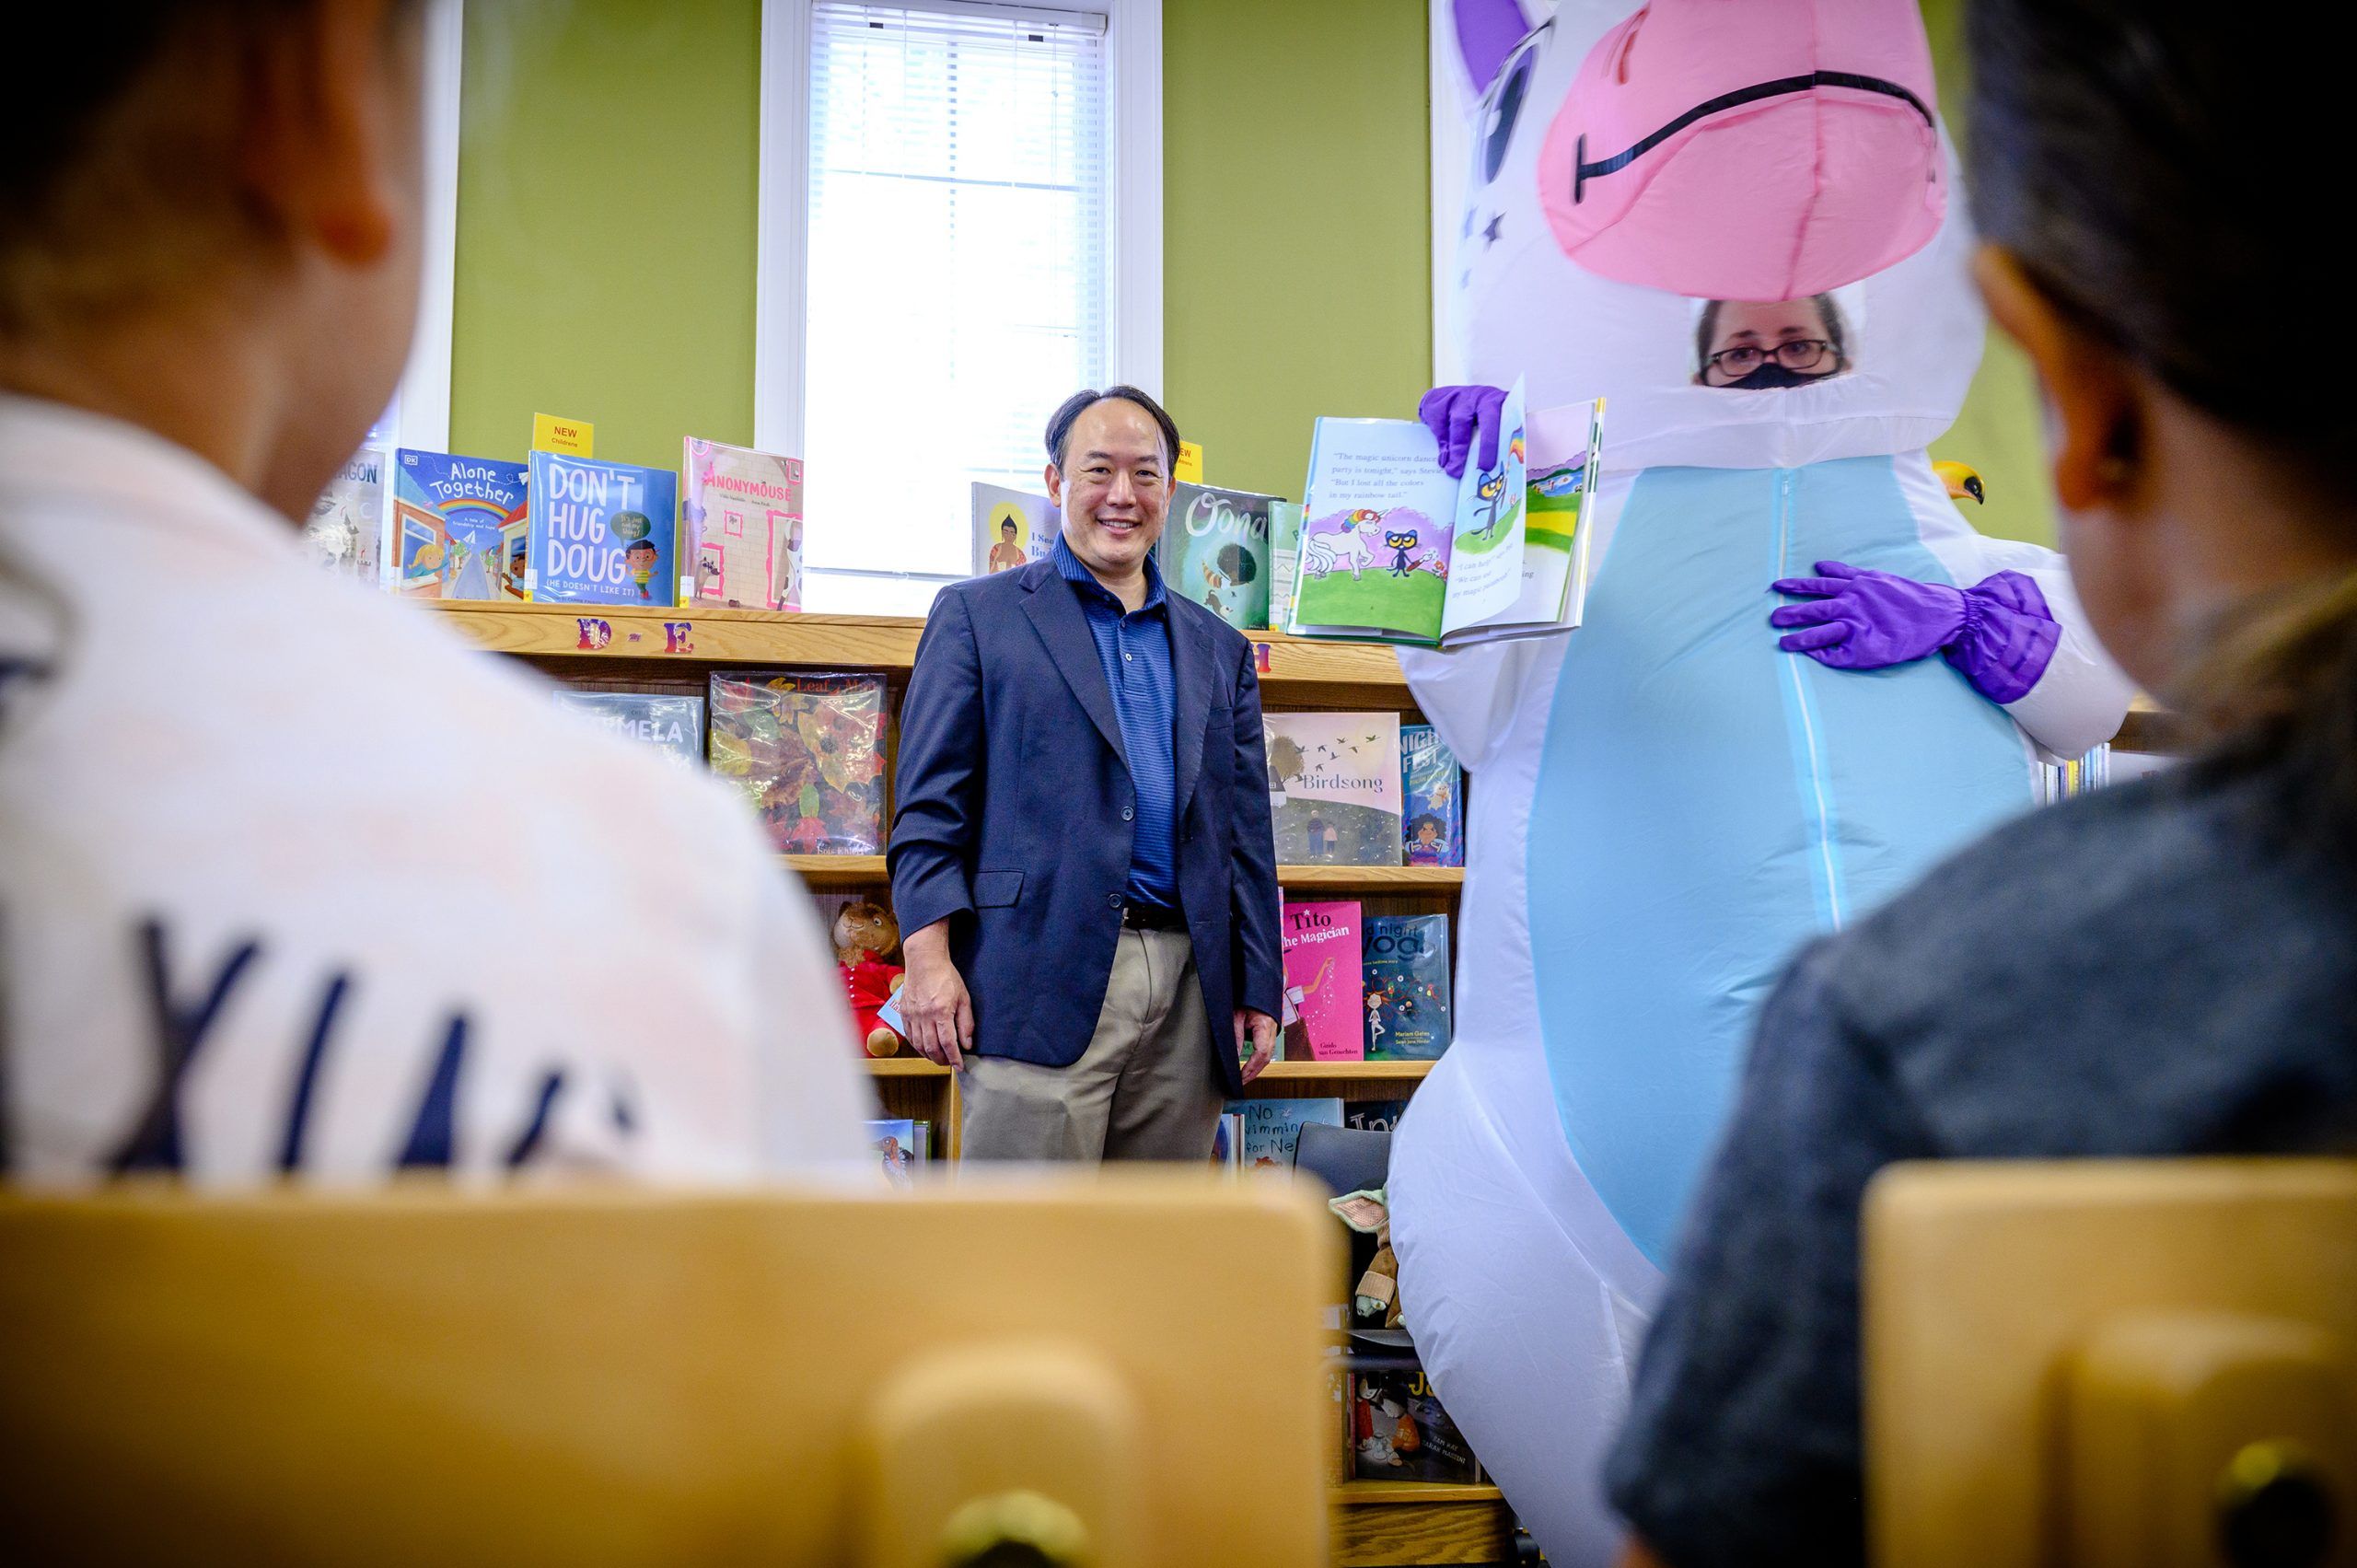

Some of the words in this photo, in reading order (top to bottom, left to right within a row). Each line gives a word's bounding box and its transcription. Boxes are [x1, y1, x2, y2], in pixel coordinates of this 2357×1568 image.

[552, 437, 578, 447] Childrens
[554, 426, 577, 438] NEW
[1179, 448, 1191, 458] EW
[1355, 454, 1378, 463] magic
[335, 461, 378, 484] AGON
[450, 462, 496, 482] Alone
[430, 481, 514, 505] Together
[549, 463, 635, 510] DON'T
[704, 472, 792, 502] ANONYMOUSE
[548, 501, 606, 544] HUG
[1186, 492, 1267, 543] Oona
[547, 539, 627, 585] DOUG
[1522, 571, 1534, 579] ing
[546, 579, 560, 587] (HE
[563, 581, 598, 591] DOESN'T
[600, 586, 620, 595] LIKE
[622, 588, 634, 597] IT)
[576, 619, 611, 649] D
[664, 622, 694, 654] E
[796, 678, 830, 693] Leaf
[619, 718, 684, 744] MELA
[1303, 773, 1384, 794] Birdsong
[1289, 911, 1331, 931] Tito
[1300, 926, 1350, 944] Magician
[1248, 1104, 1272, 1121] No
[1246, 1143, 1264, 1153] for
[1271, 1140, 1295, 1154] Ne
